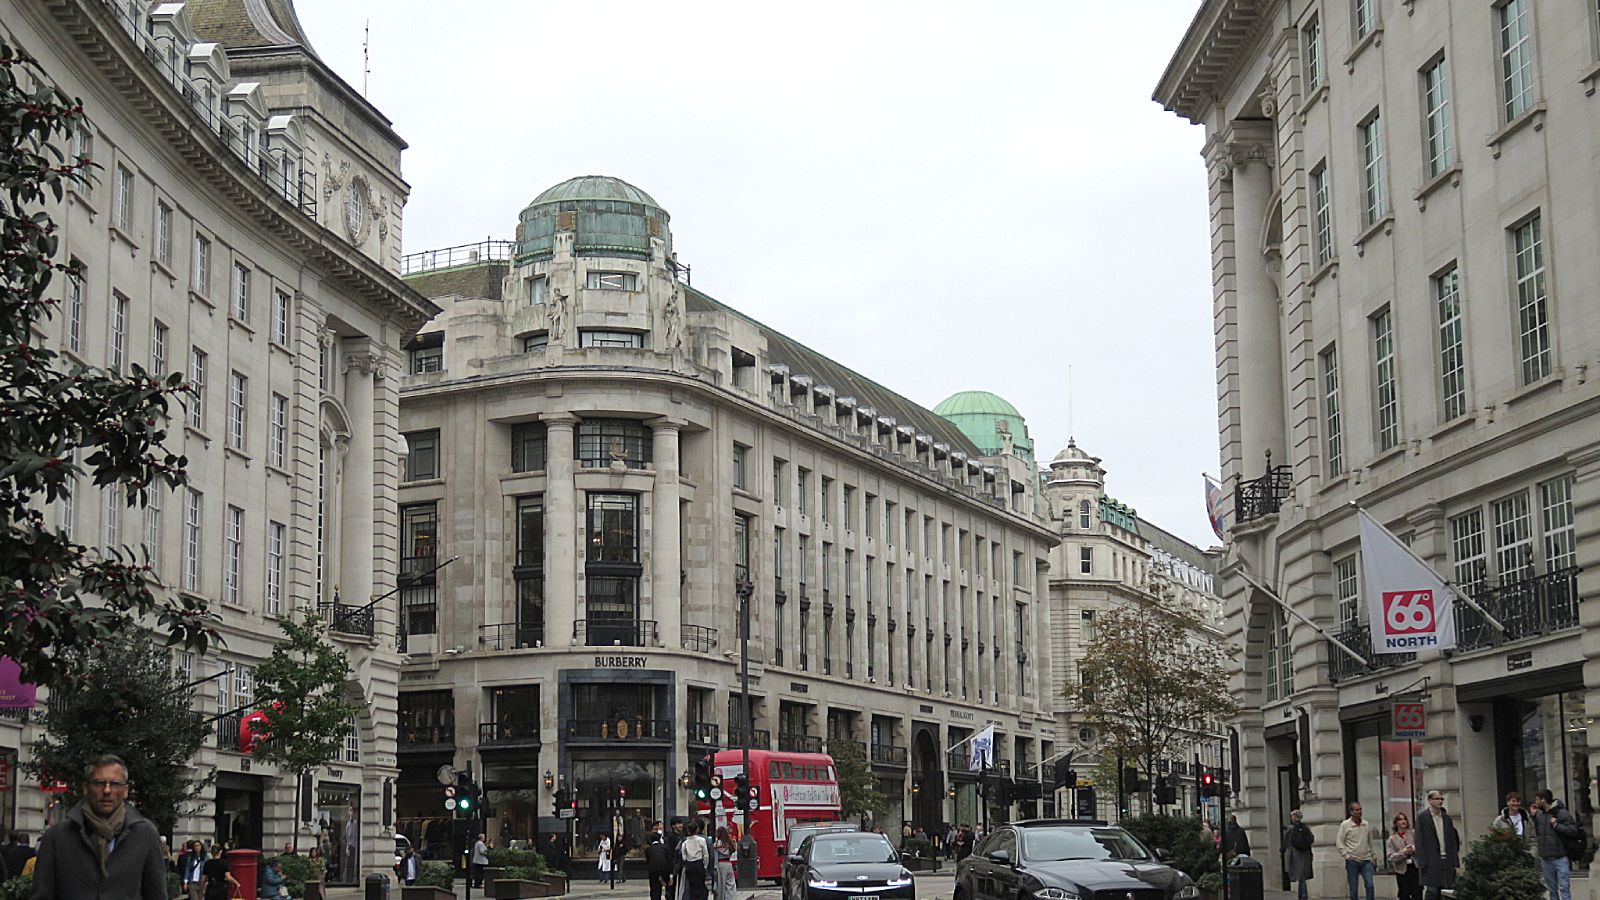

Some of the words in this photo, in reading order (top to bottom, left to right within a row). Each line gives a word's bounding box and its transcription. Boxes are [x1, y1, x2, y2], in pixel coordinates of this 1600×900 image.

[1386, 636, 1437, 648] NORTH
[595, 656, 648, 668] BURBERRY
[327, 766, 343, 780] Theory
